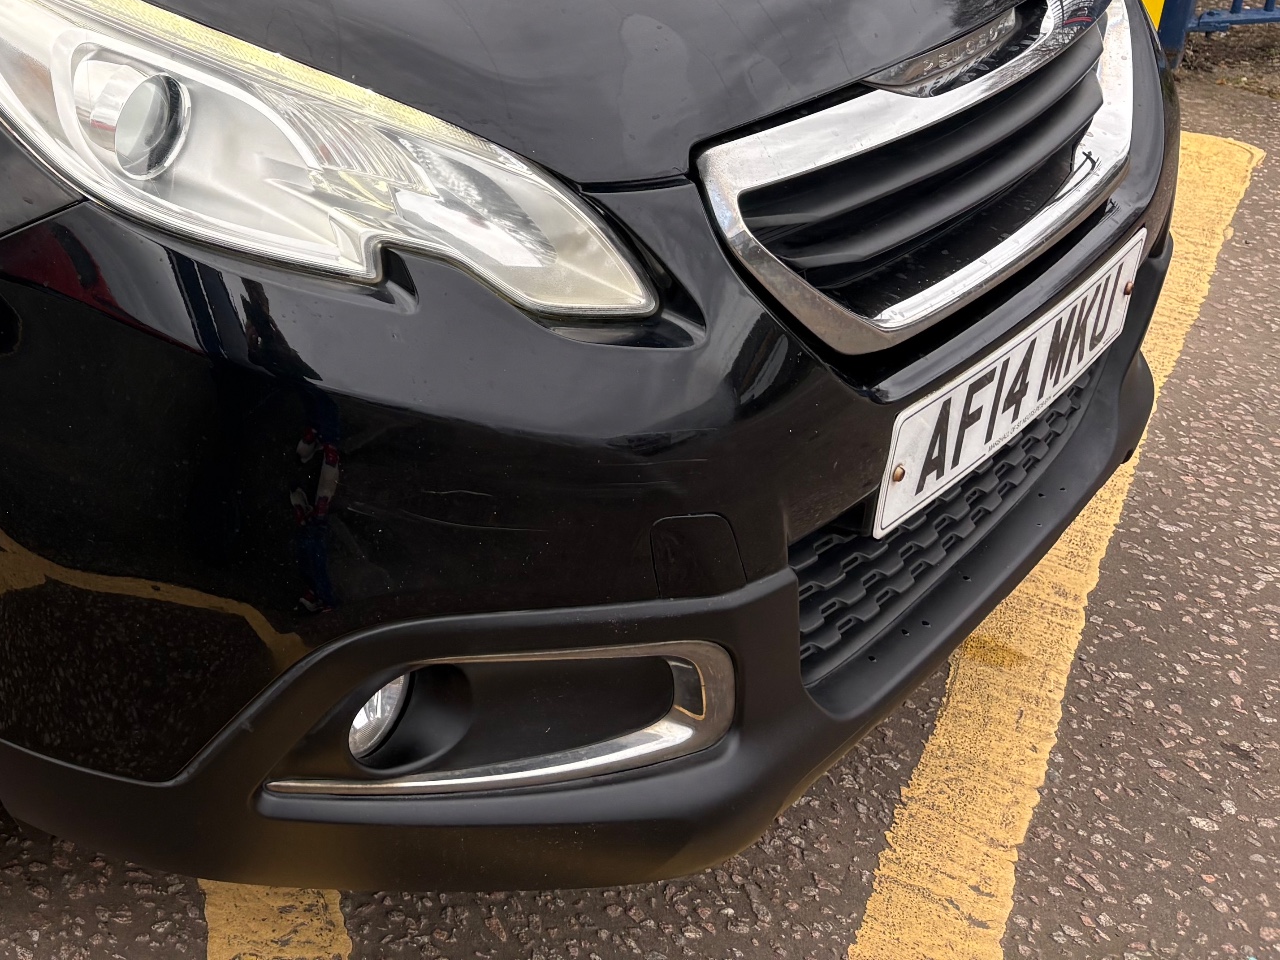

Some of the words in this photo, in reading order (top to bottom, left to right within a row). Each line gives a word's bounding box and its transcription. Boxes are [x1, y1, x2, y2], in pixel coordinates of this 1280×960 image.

[922, 17, 1009, 76] PEUGEOT
[915, 336, 1037, 497] AF14
[1037, 262, 1124, 402] MKU
